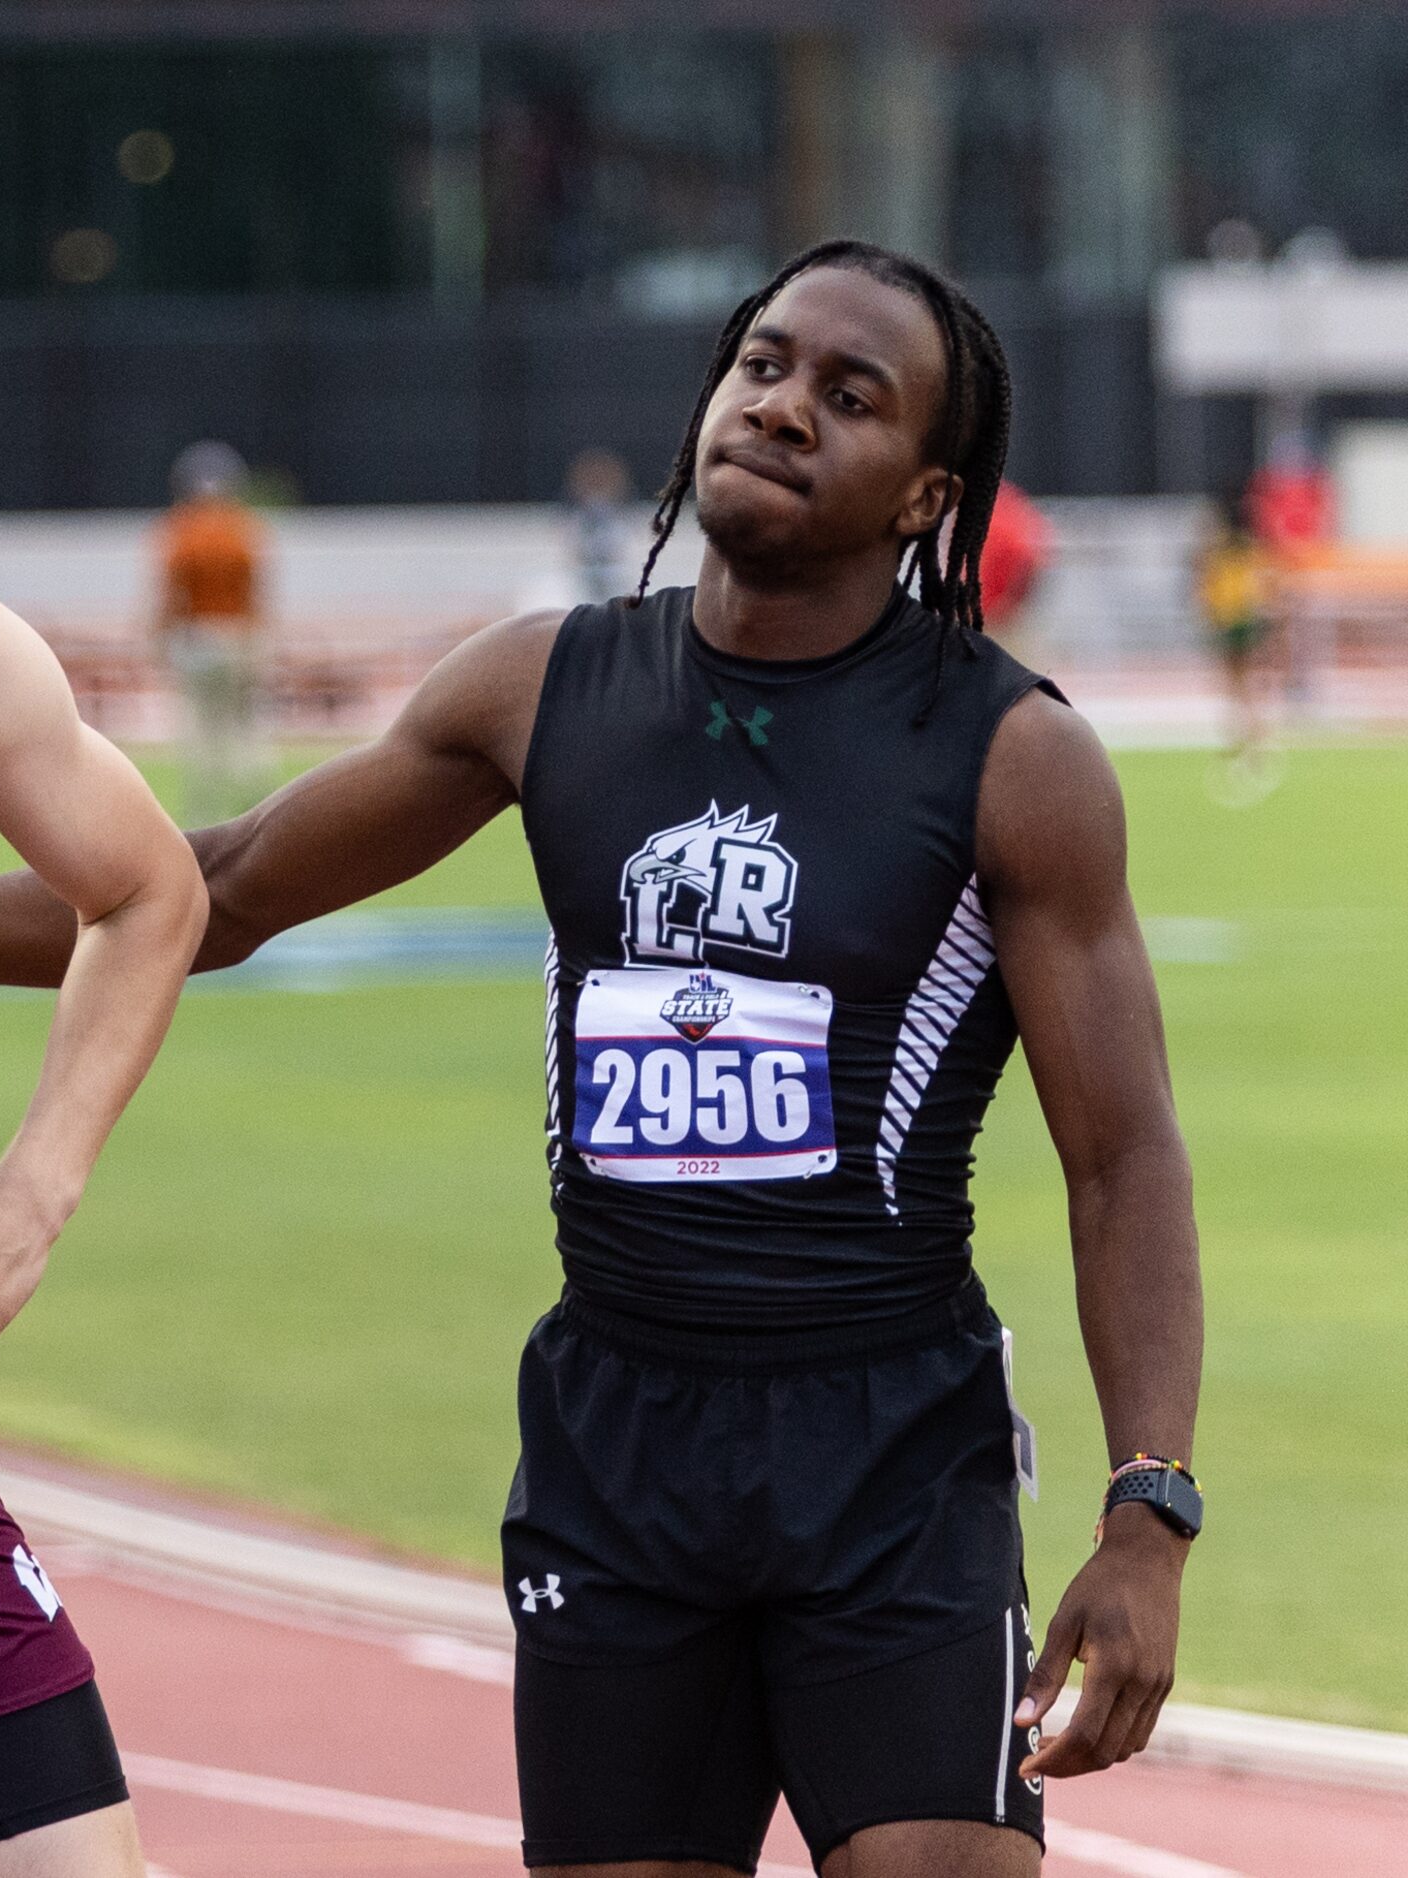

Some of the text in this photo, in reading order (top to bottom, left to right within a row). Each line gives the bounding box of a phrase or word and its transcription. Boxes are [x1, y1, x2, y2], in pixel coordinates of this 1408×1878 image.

[661, 998, 732, 1016] STATE
[590, 1048, 810, 1145] 2956
[676, 1160, 721, 1175] 2022
